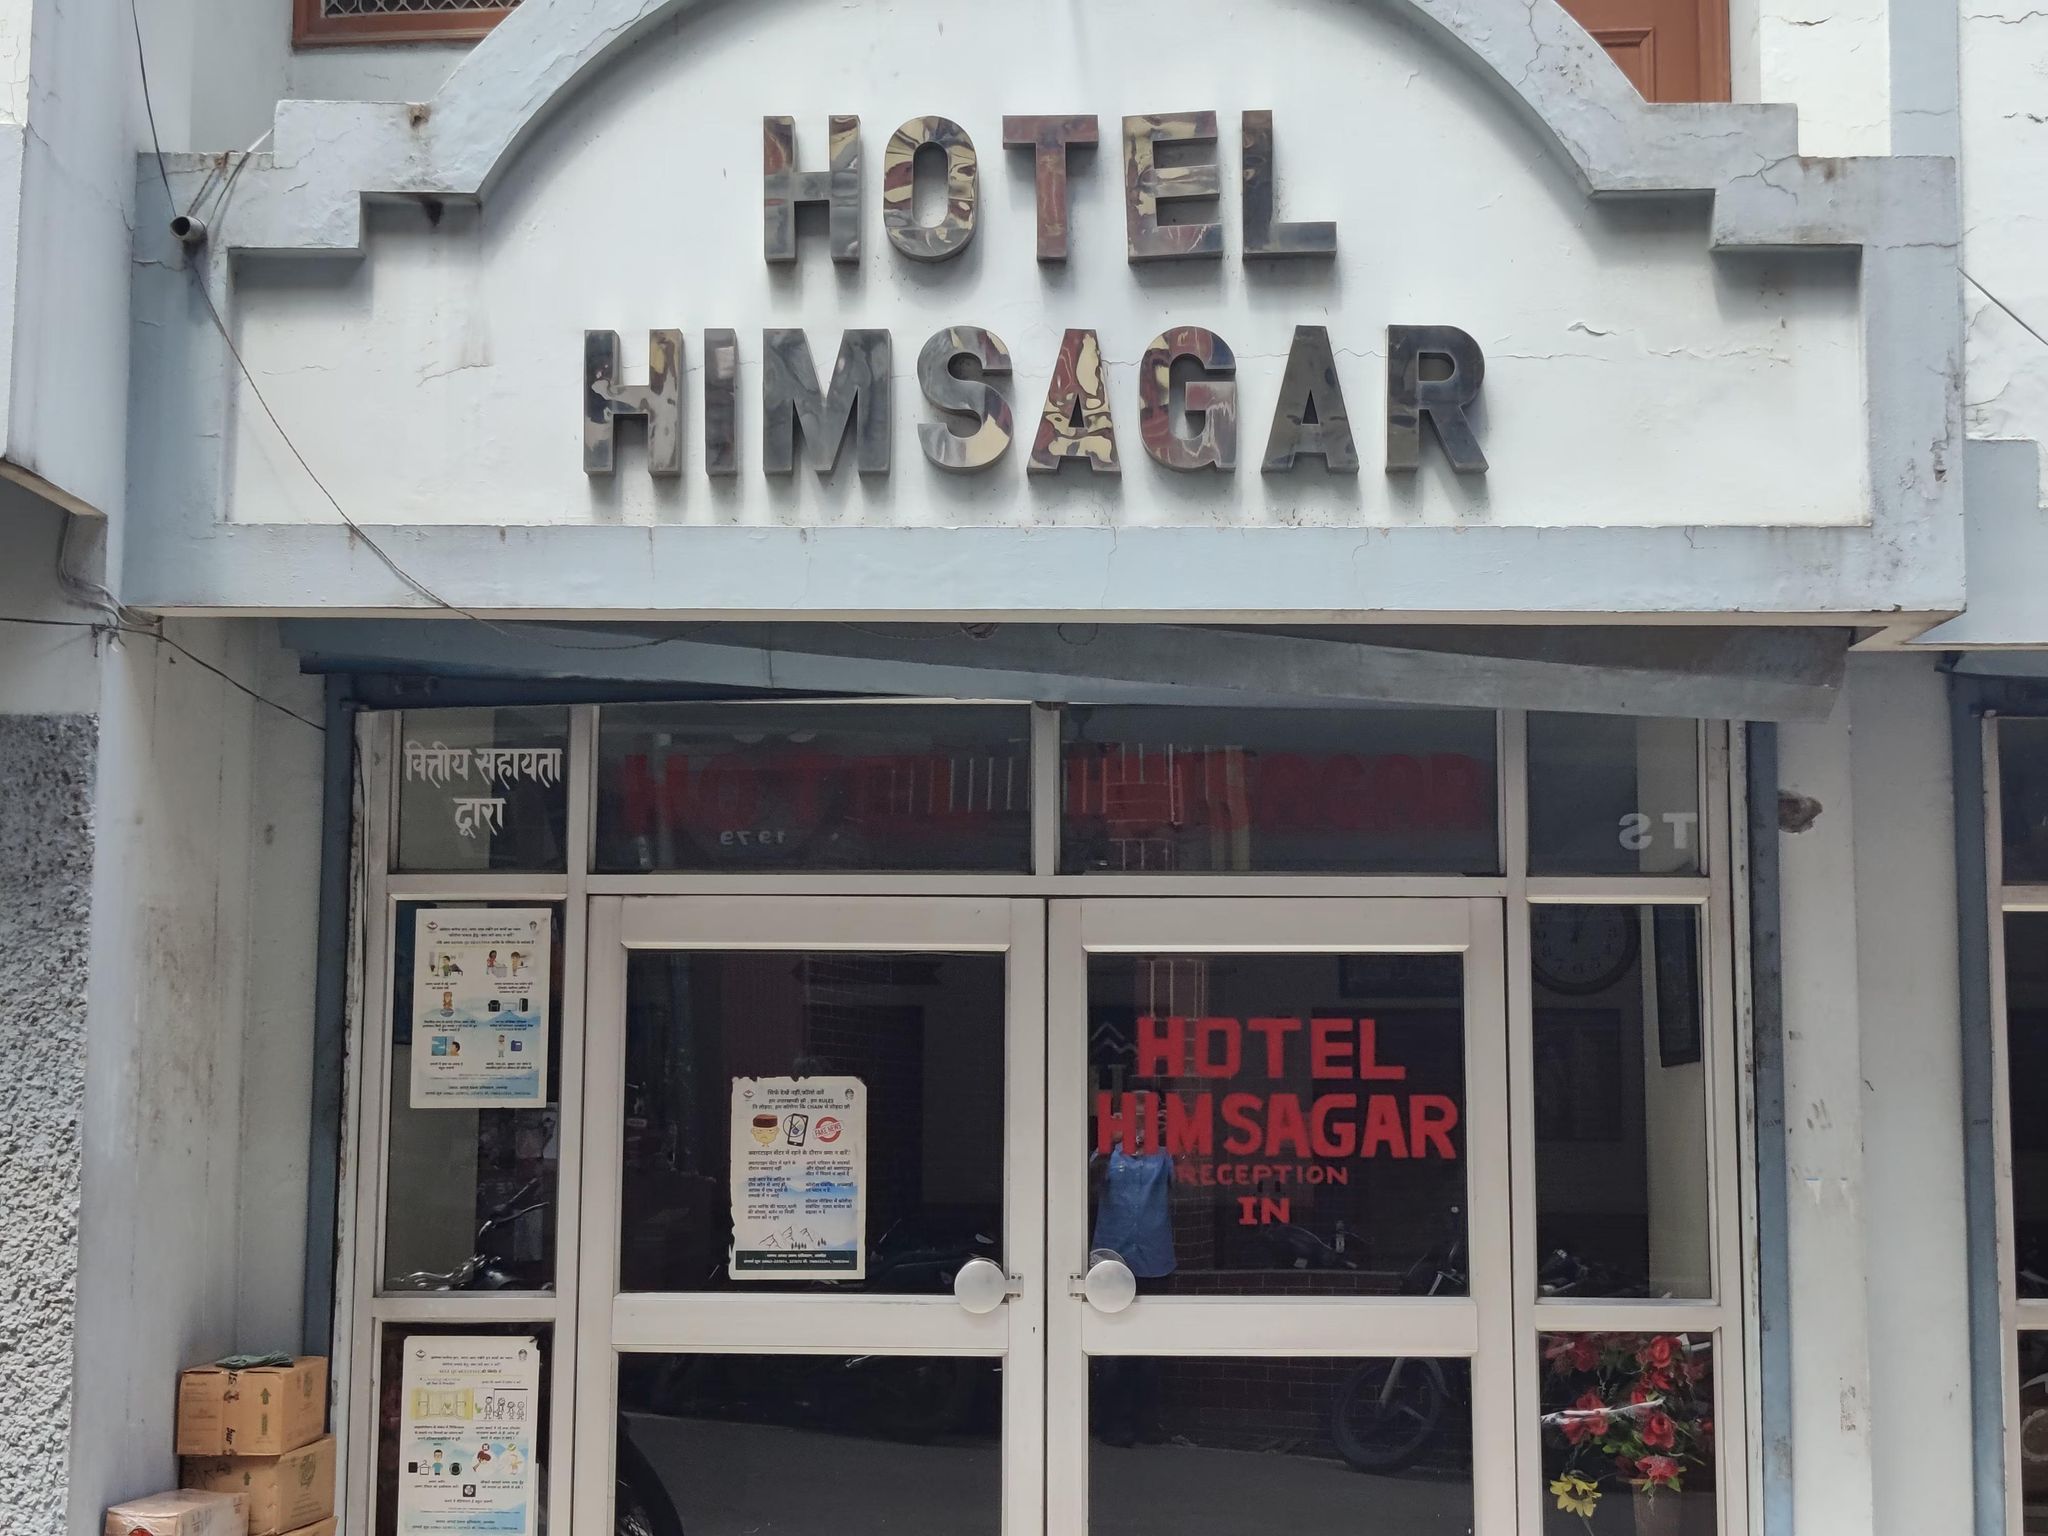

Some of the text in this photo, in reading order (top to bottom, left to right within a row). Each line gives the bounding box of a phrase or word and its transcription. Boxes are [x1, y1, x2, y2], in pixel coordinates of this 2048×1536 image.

[763, 110, 1337, 265] HOTEL
[584, 325, 1488, 477] HIMSAGAR
[475, 748, 563, 790] सहायता
[453, 798, 507, 839] द्वारा
[1137, 1016, 1406, 1080] HOTEL
[1097, 1092, 1458, 1159] HIMSAGAR
[1174, 1164, 1349, 1185] RECEPTION
[1238, 1196, 1290, 1225] IN
